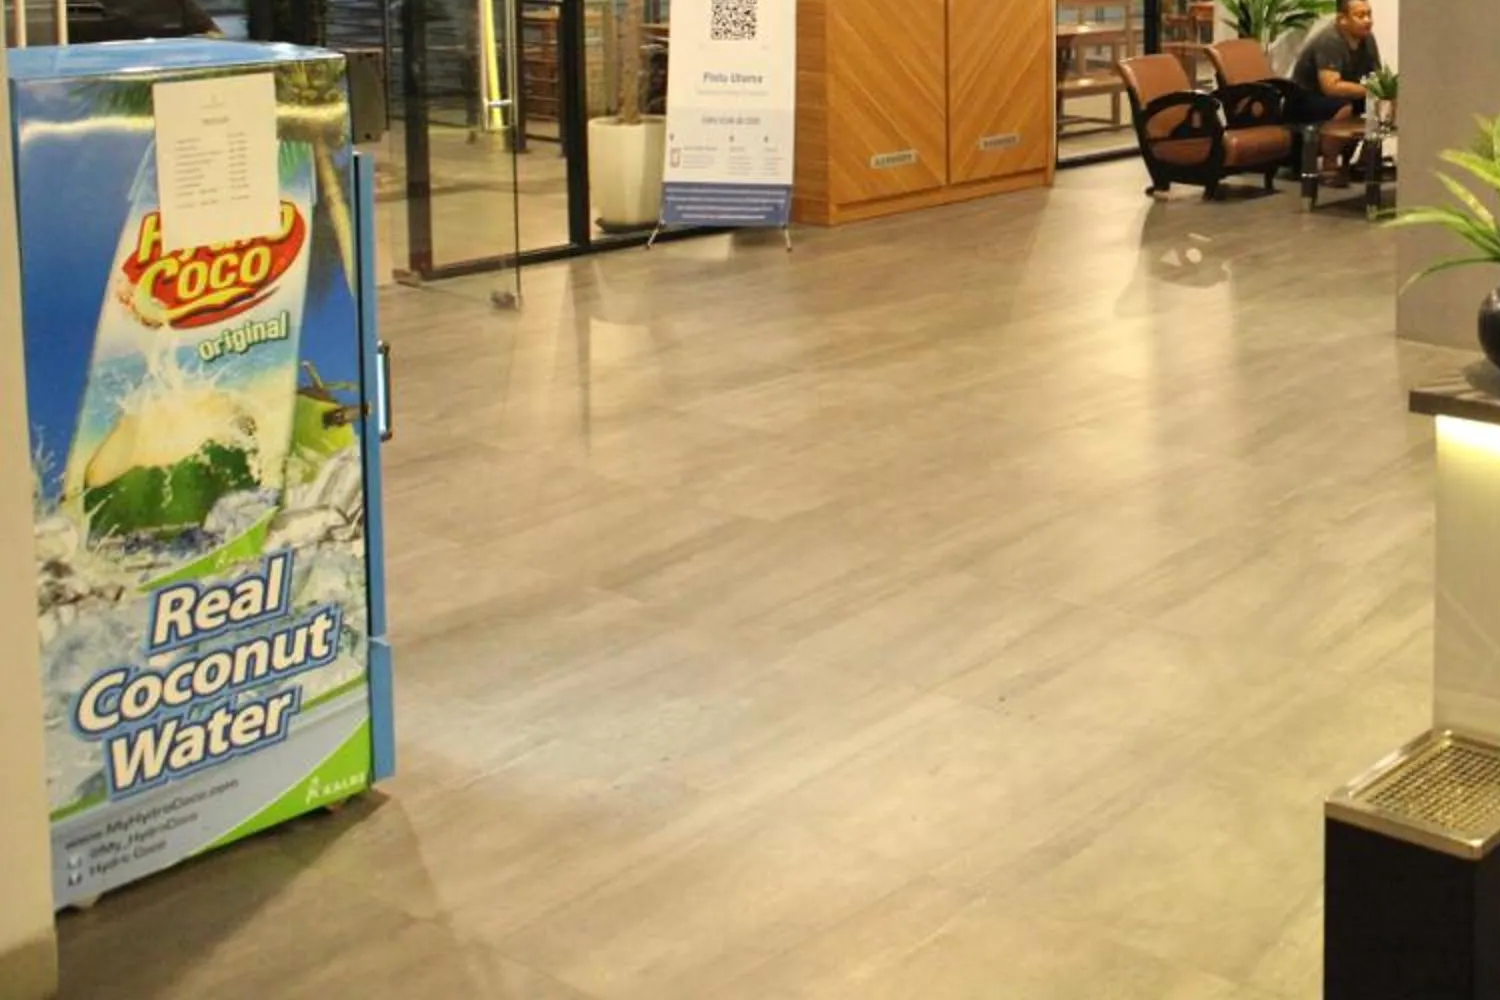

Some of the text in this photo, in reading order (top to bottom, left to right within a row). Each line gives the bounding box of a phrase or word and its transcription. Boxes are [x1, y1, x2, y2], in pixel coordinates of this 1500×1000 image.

[198, 311, 290, 362] original
[152, 556, 284, 647] Real
[77, 614, 334, 732] Coconut
[110, 698, 293, 790] Water
